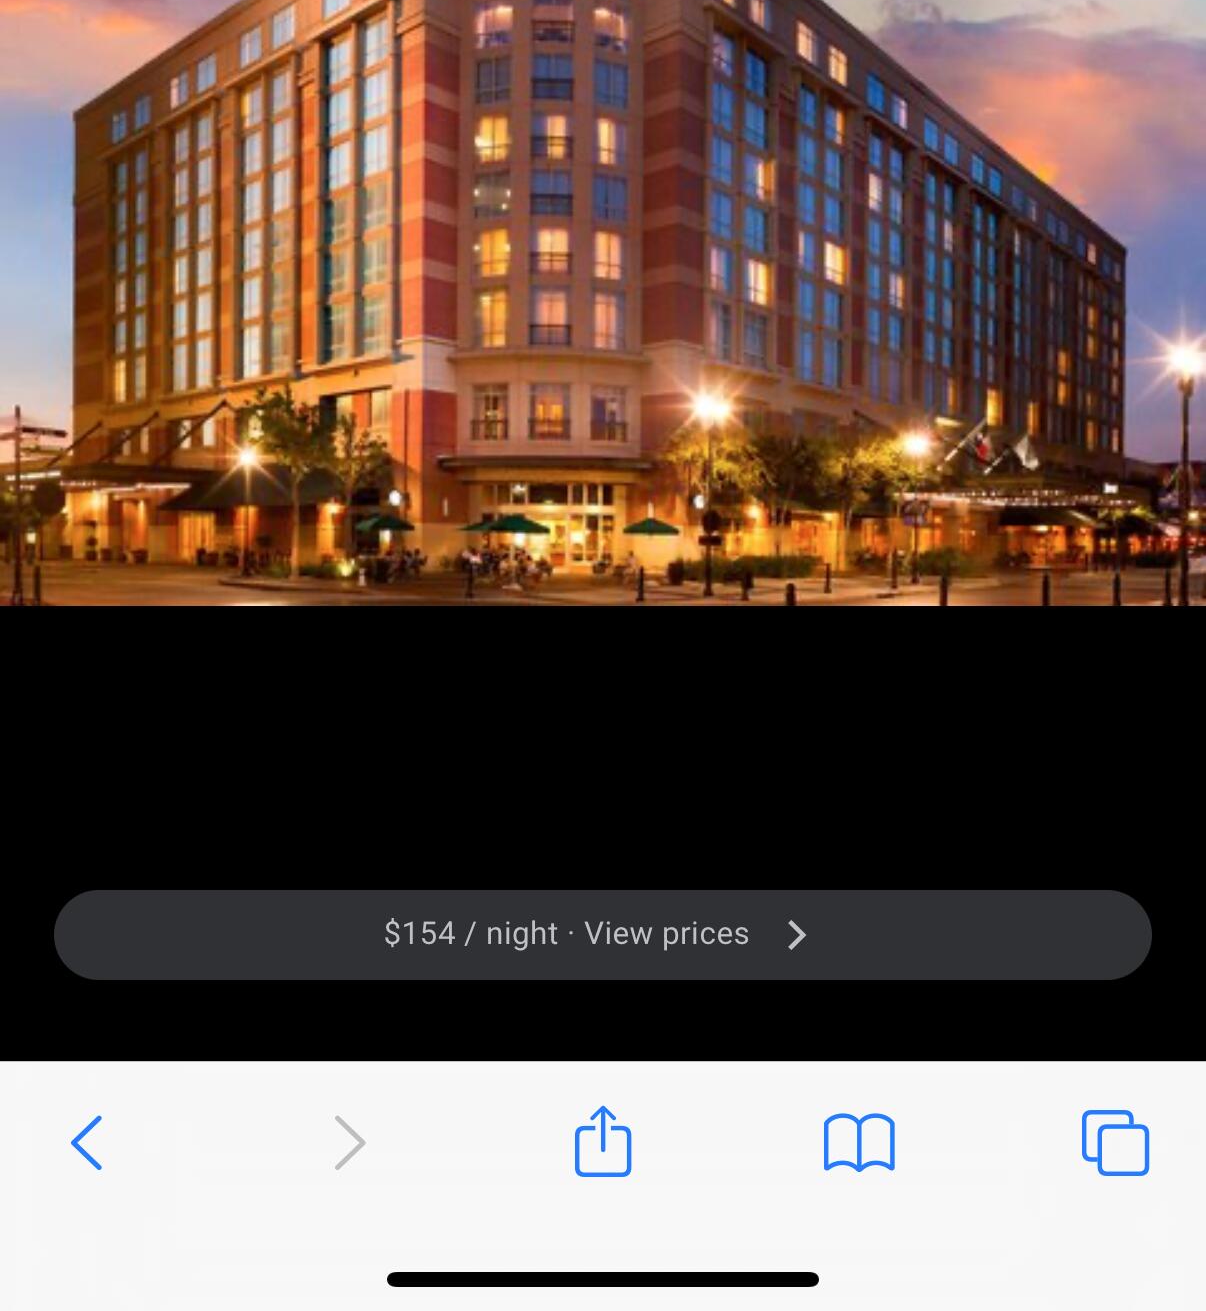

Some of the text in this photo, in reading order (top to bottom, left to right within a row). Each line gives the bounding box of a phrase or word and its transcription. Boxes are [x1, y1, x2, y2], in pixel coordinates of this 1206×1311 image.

[384, 917, 456, 948] $154
[487, 919, 558, 952] night
[584, 920, 653, 945] View
[663, 920, 749, 952] prices
